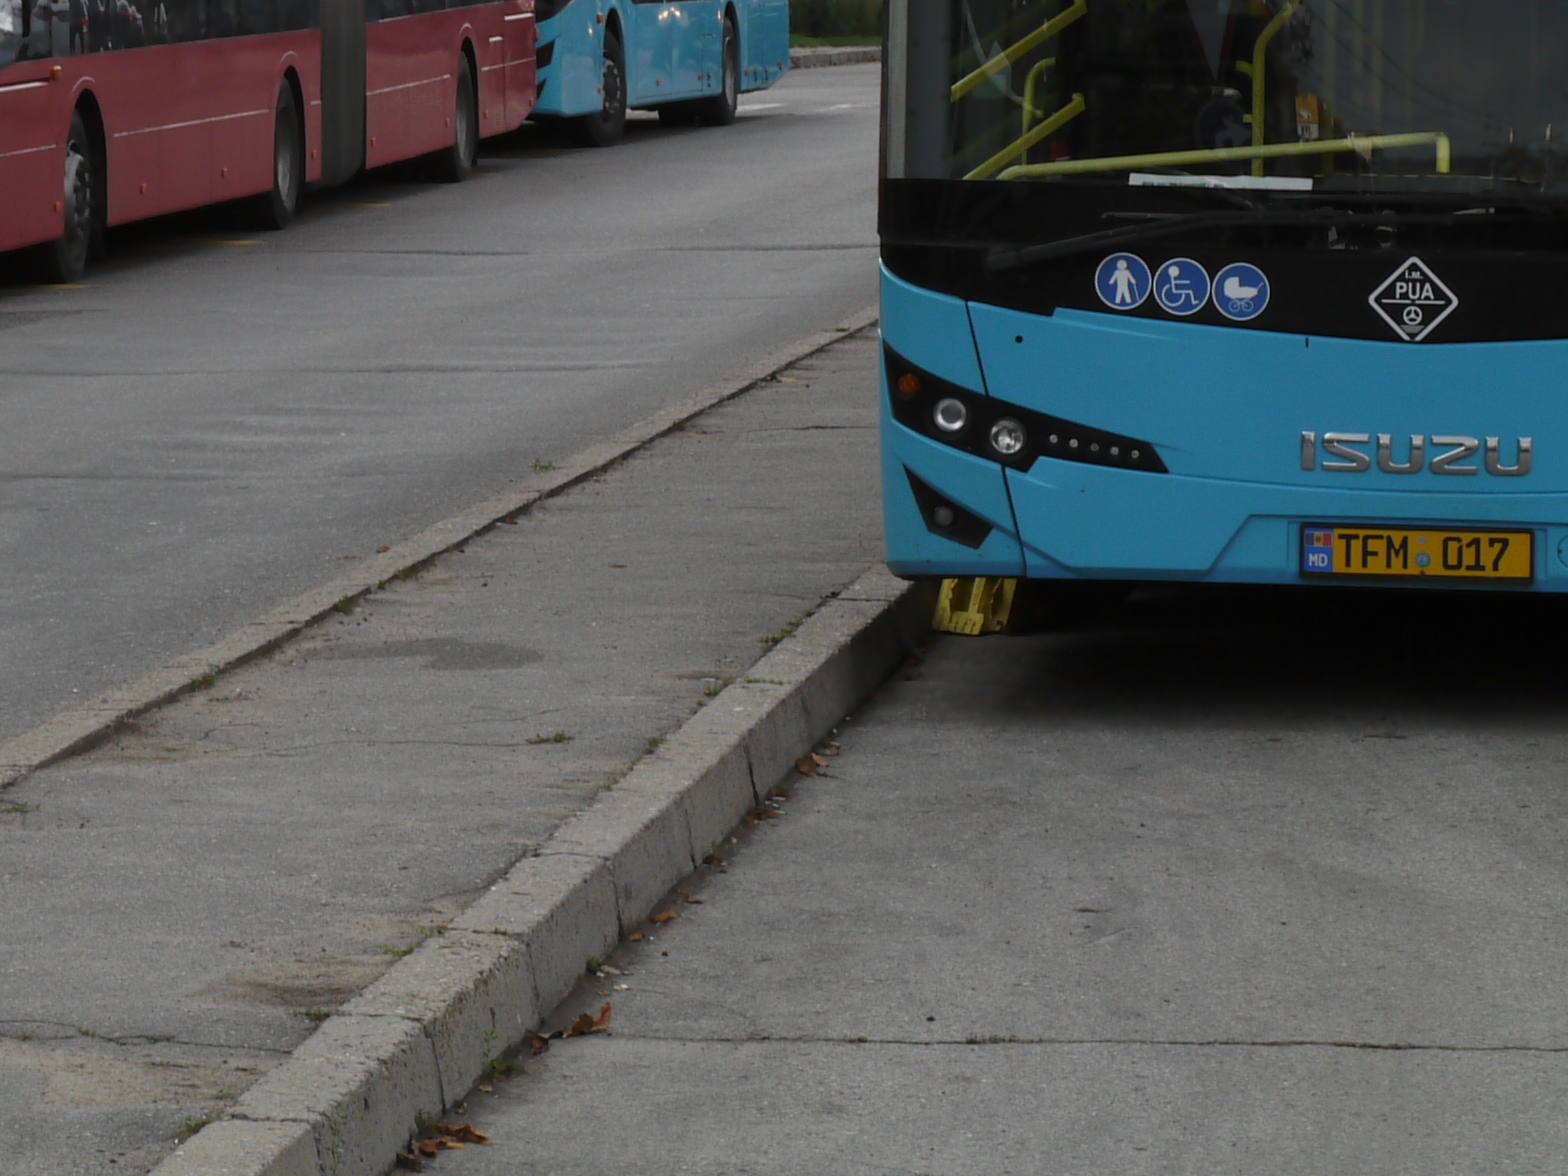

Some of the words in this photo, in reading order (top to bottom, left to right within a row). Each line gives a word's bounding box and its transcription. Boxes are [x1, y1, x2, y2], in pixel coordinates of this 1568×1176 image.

[1395, 281, 1435, 300] PUA
[1300, 430, 1532, 476] ISUZU
[1308, 553, 1329, 568] MD
[1337, 533, 1409, 570] TFM
[1441, 535, 1510, 572] 017
